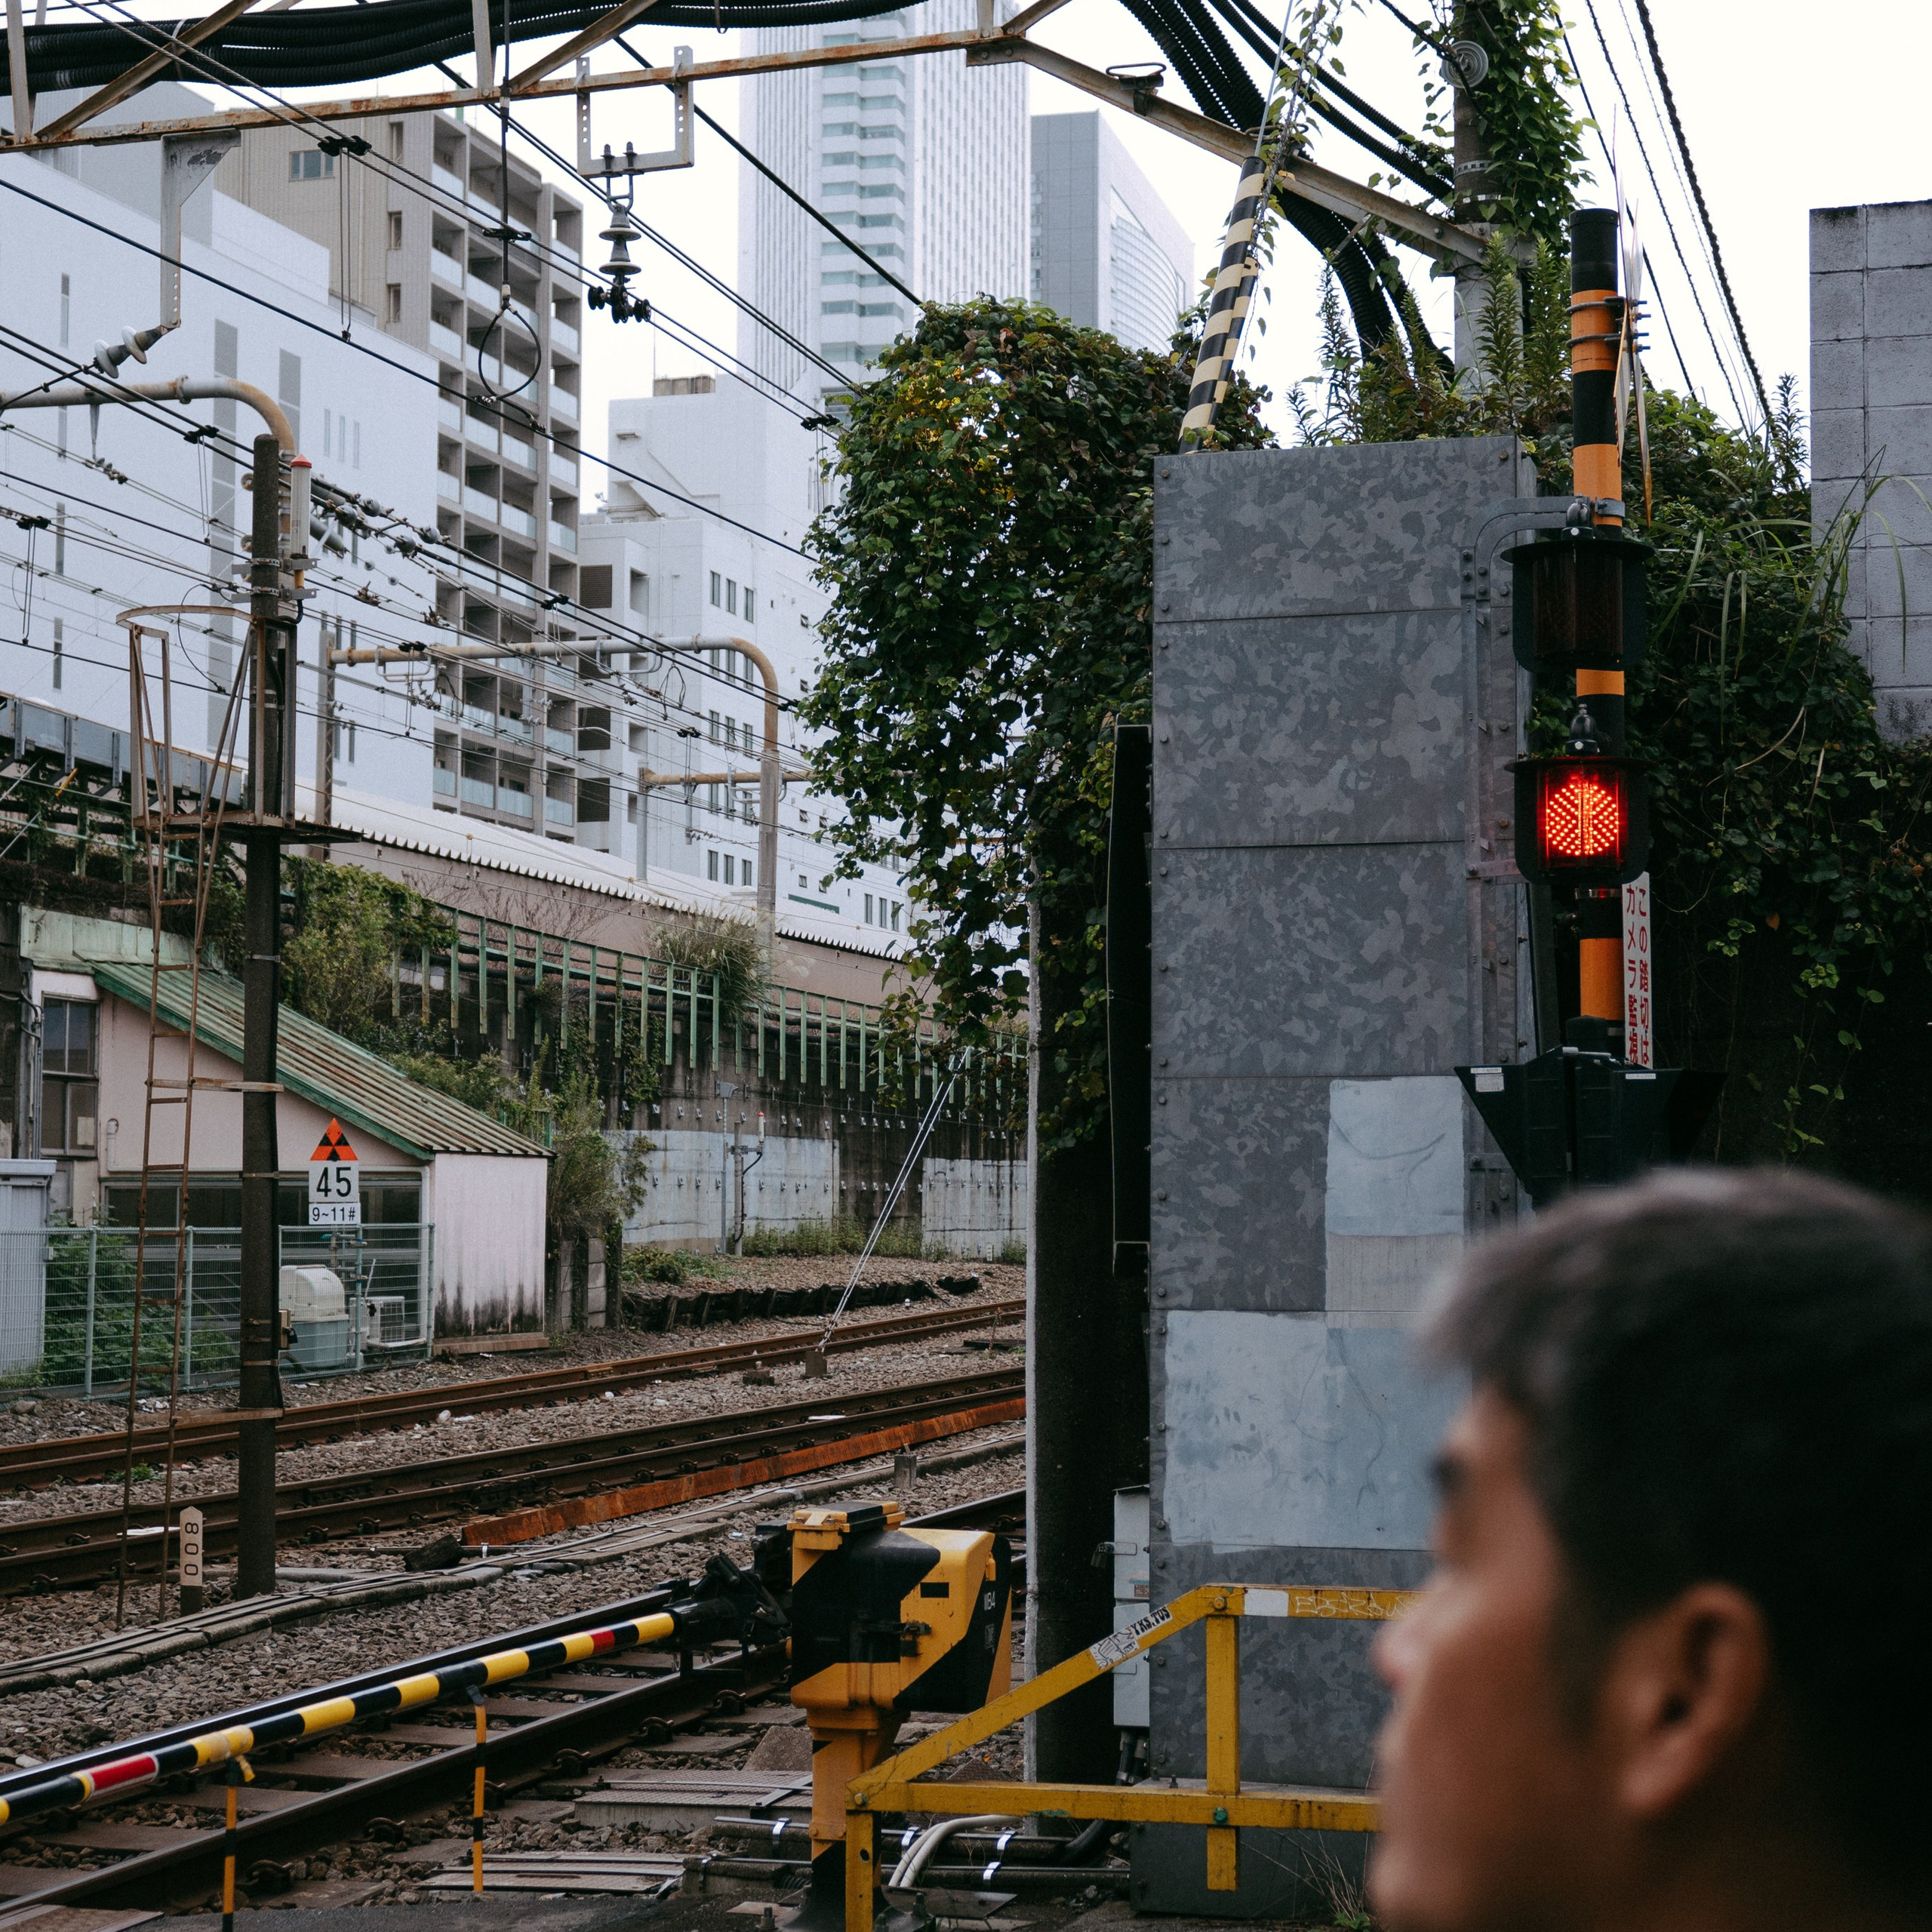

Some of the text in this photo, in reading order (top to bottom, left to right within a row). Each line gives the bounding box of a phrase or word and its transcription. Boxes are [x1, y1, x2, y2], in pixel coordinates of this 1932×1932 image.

[1626, 884, 1638, 1064] カメラ監視
[1638, 888, 1650, 1065] この踏切は
[316, 1167, 352, 1198] 45
[184, 1522, 199, 1576] 800
